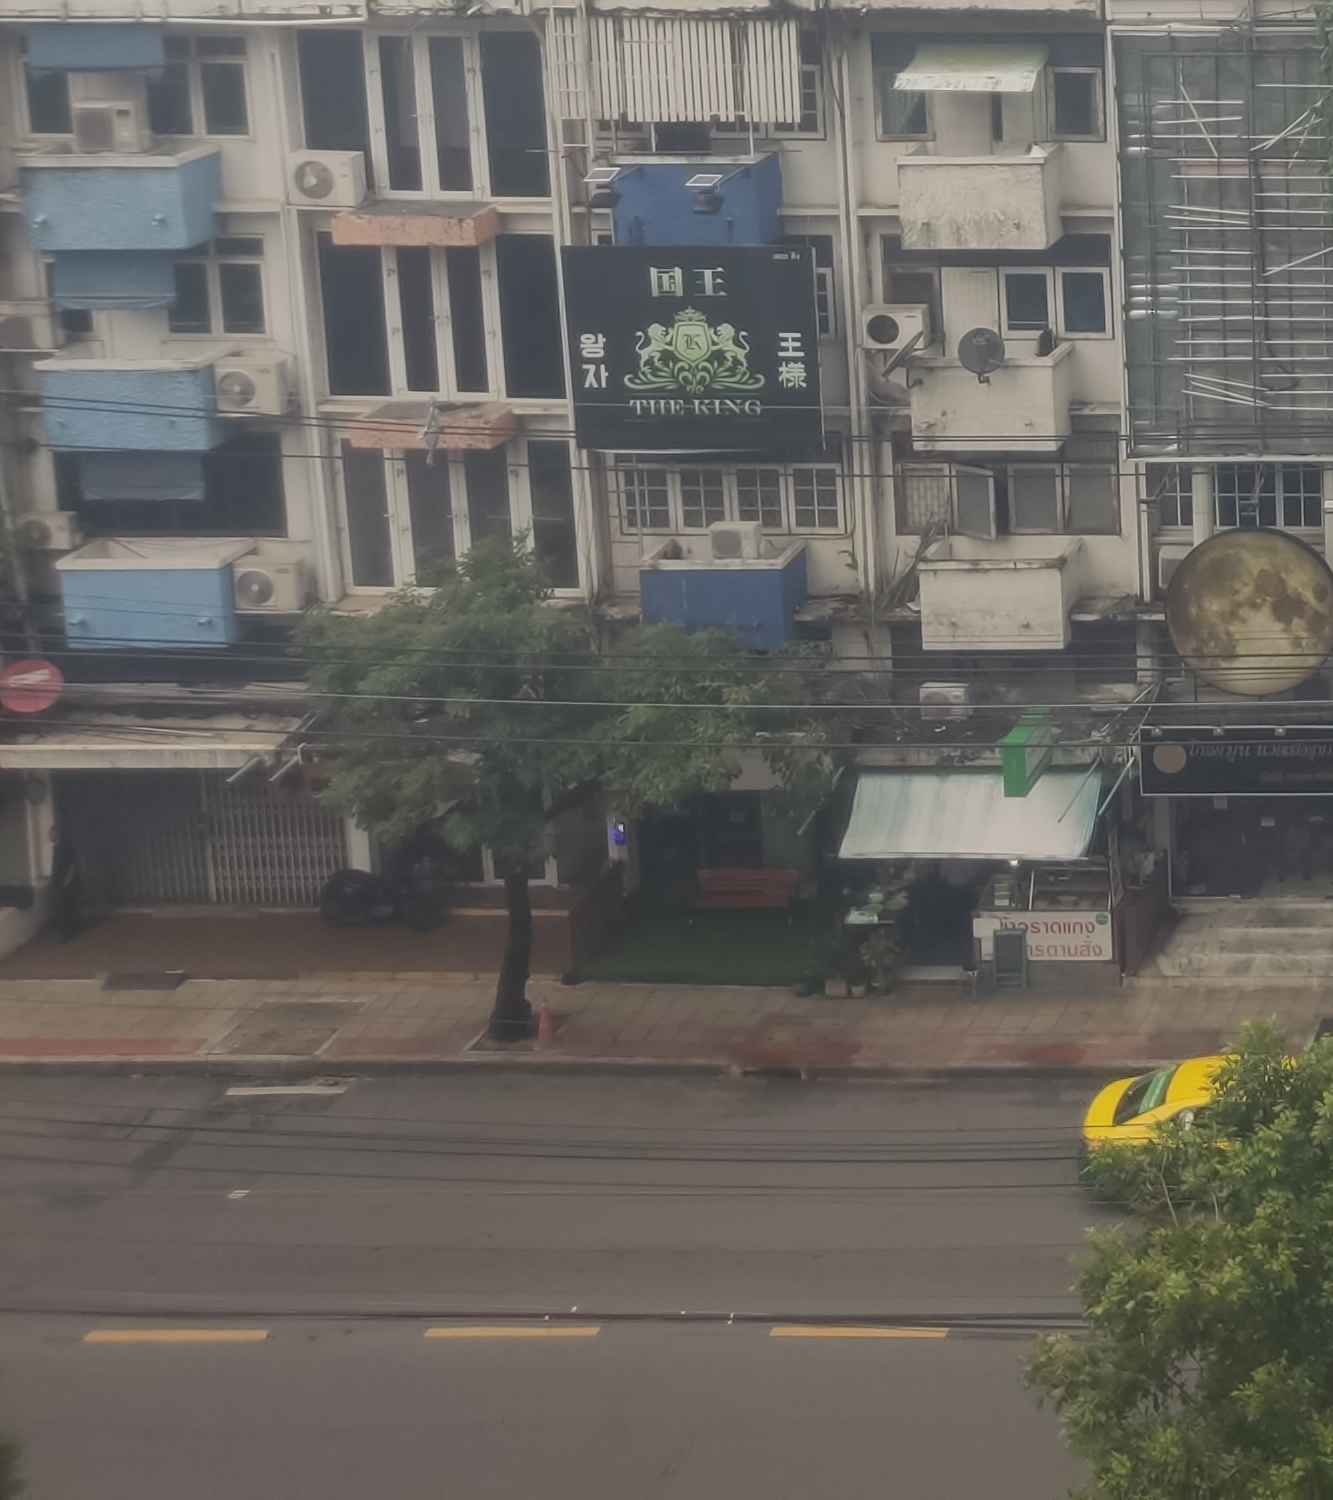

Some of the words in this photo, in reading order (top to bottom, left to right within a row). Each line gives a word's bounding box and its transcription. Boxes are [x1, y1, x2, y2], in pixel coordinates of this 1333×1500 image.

[580, 333, 608, 389] 왕자
[778, 332, 807, 389] 王様
[629, 399, 684, 416] THE
[694, 399, 761, 416] KING
